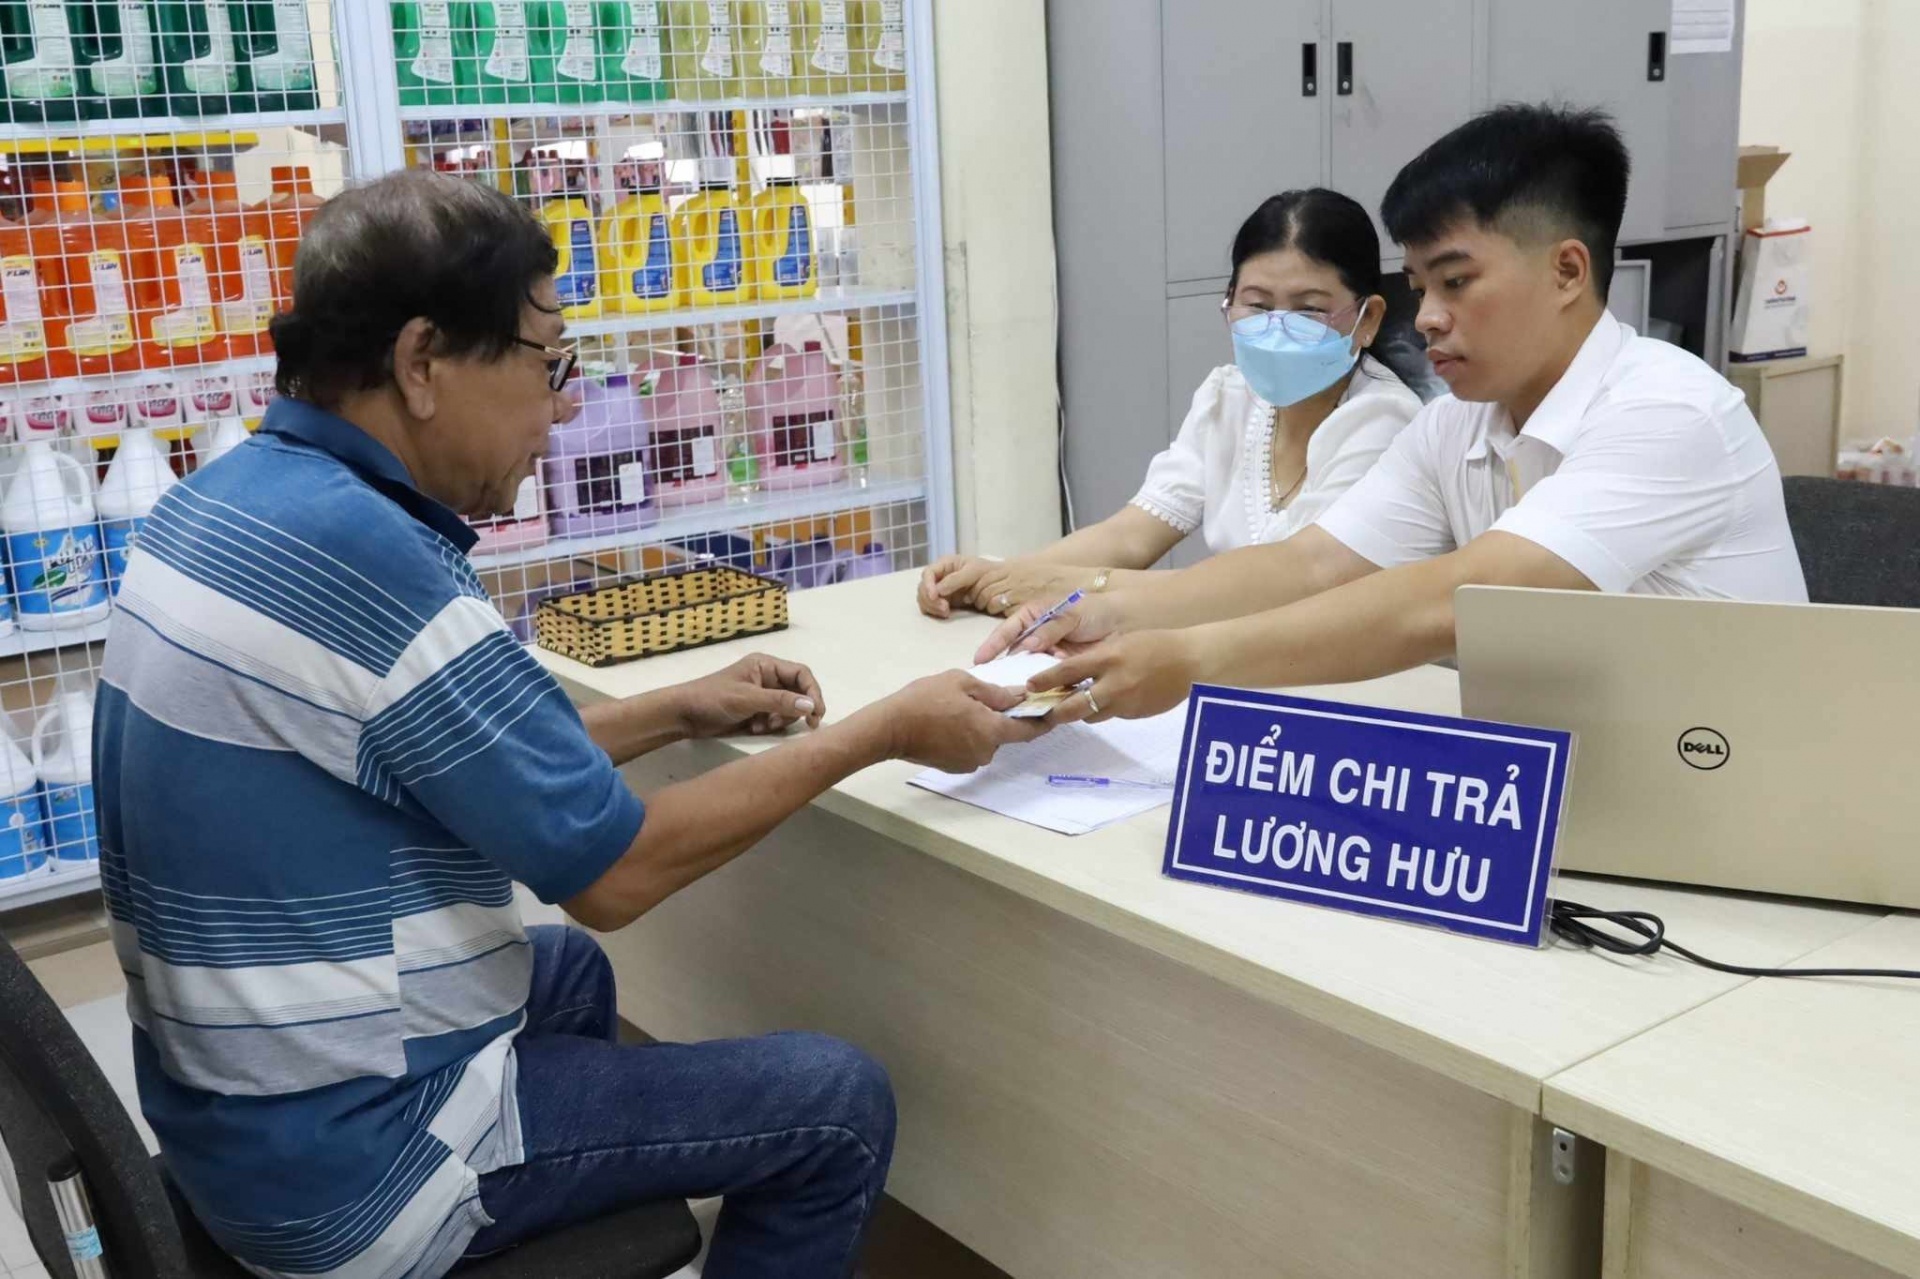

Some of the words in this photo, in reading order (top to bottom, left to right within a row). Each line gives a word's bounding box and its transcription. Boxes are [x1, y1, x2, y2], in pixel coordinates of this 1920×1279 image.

[1206, 724, 1316, 797] ĐIỂM
[1329, 758, 1411, 812] CHI
[1426, 763, 1522, 831] TRẢ
[1683, 741, 1724, 755] DELL
[1213, 814, 1371, 882] LƯƠNG
[1386, 842, 1491, 903] HƯU
